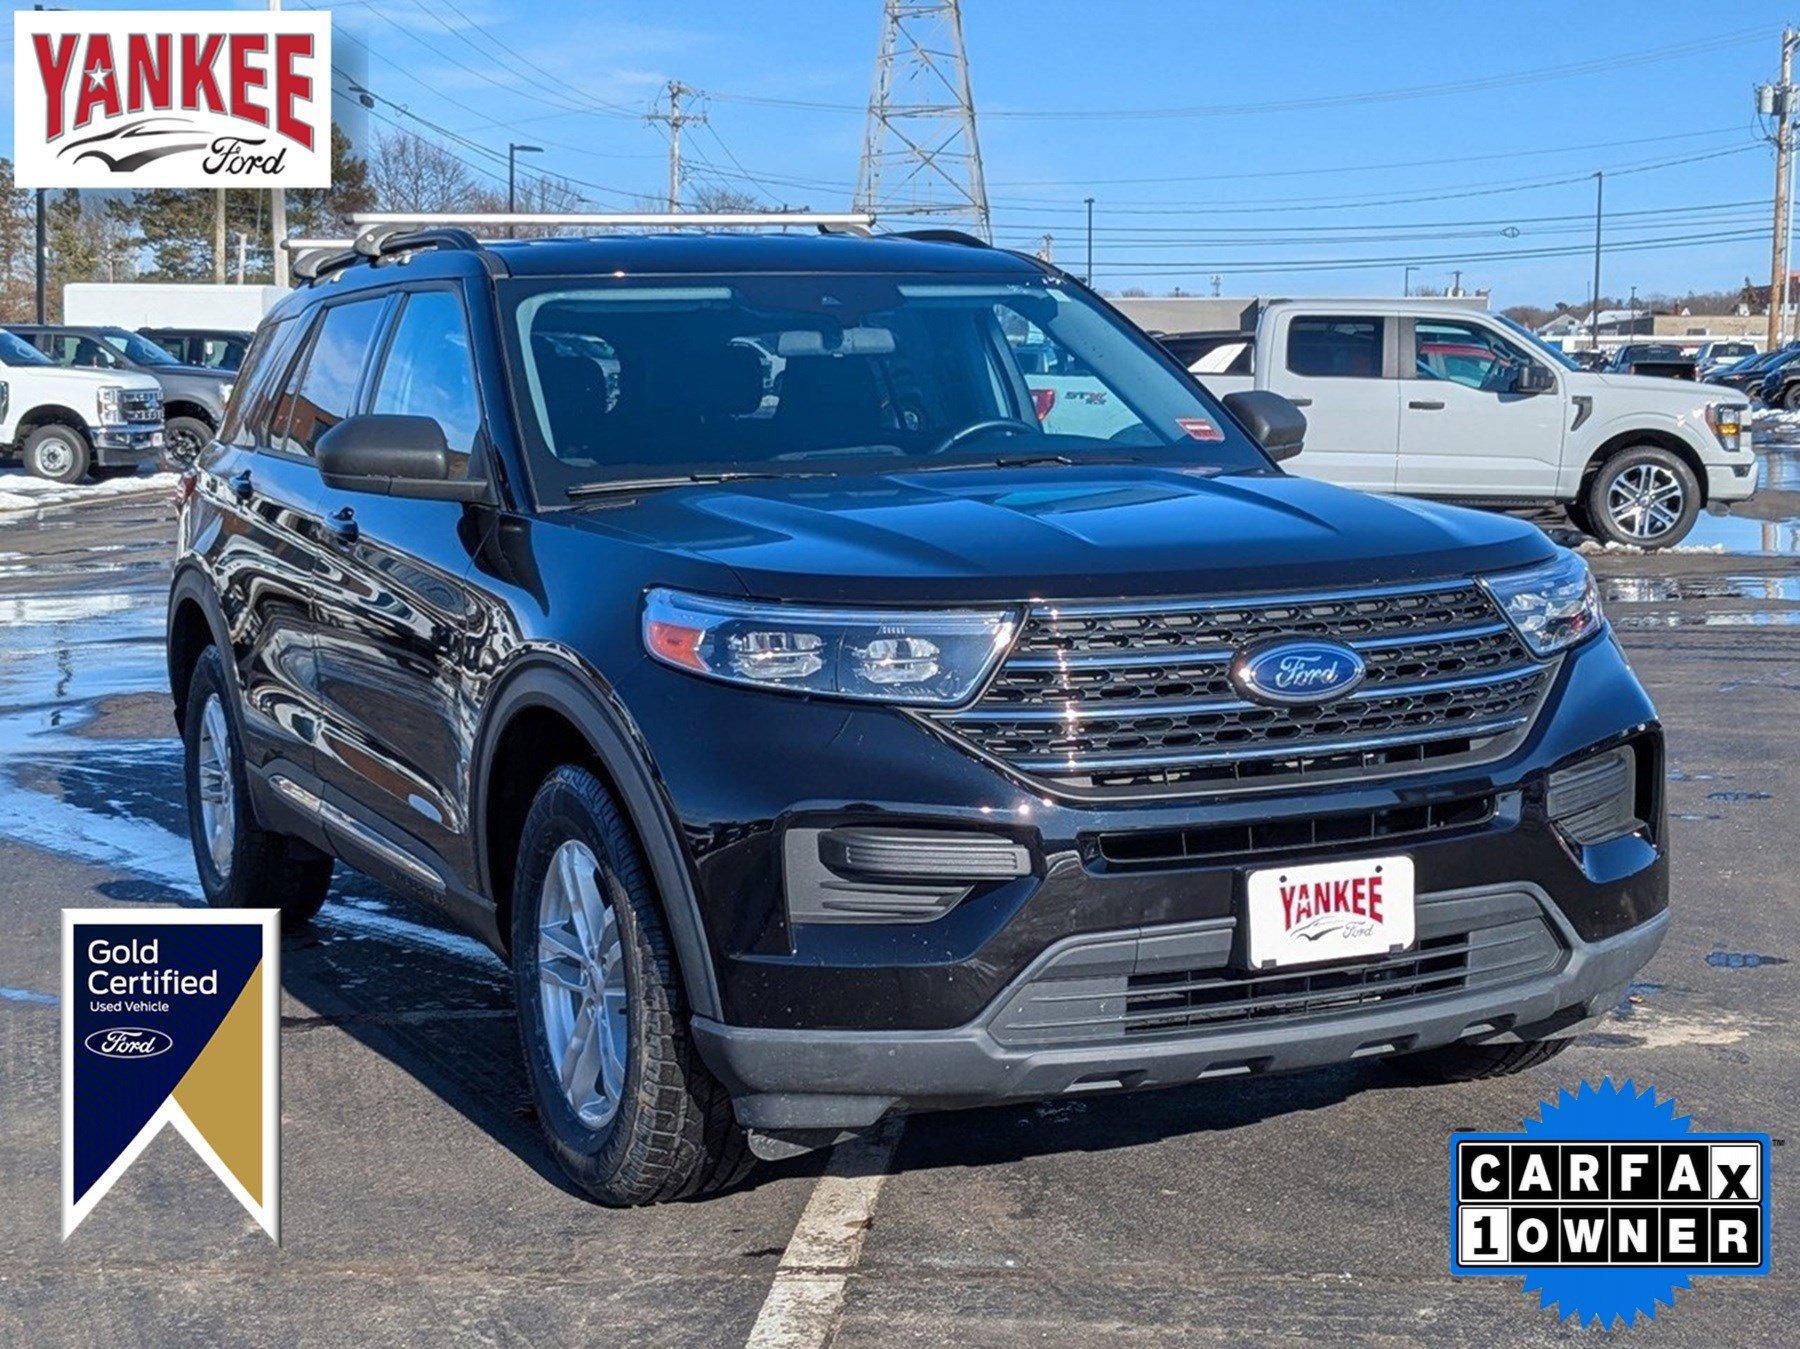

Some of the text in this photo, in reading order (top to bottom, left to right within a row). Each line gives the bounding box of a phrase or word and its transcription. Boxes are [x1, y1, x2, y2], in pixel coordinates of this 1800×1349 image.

[1276, 655, 1338, 688] Ford
[1280, 876, 1383, 931] YANKEE
[1342, 921, 1374, 939] Ford
